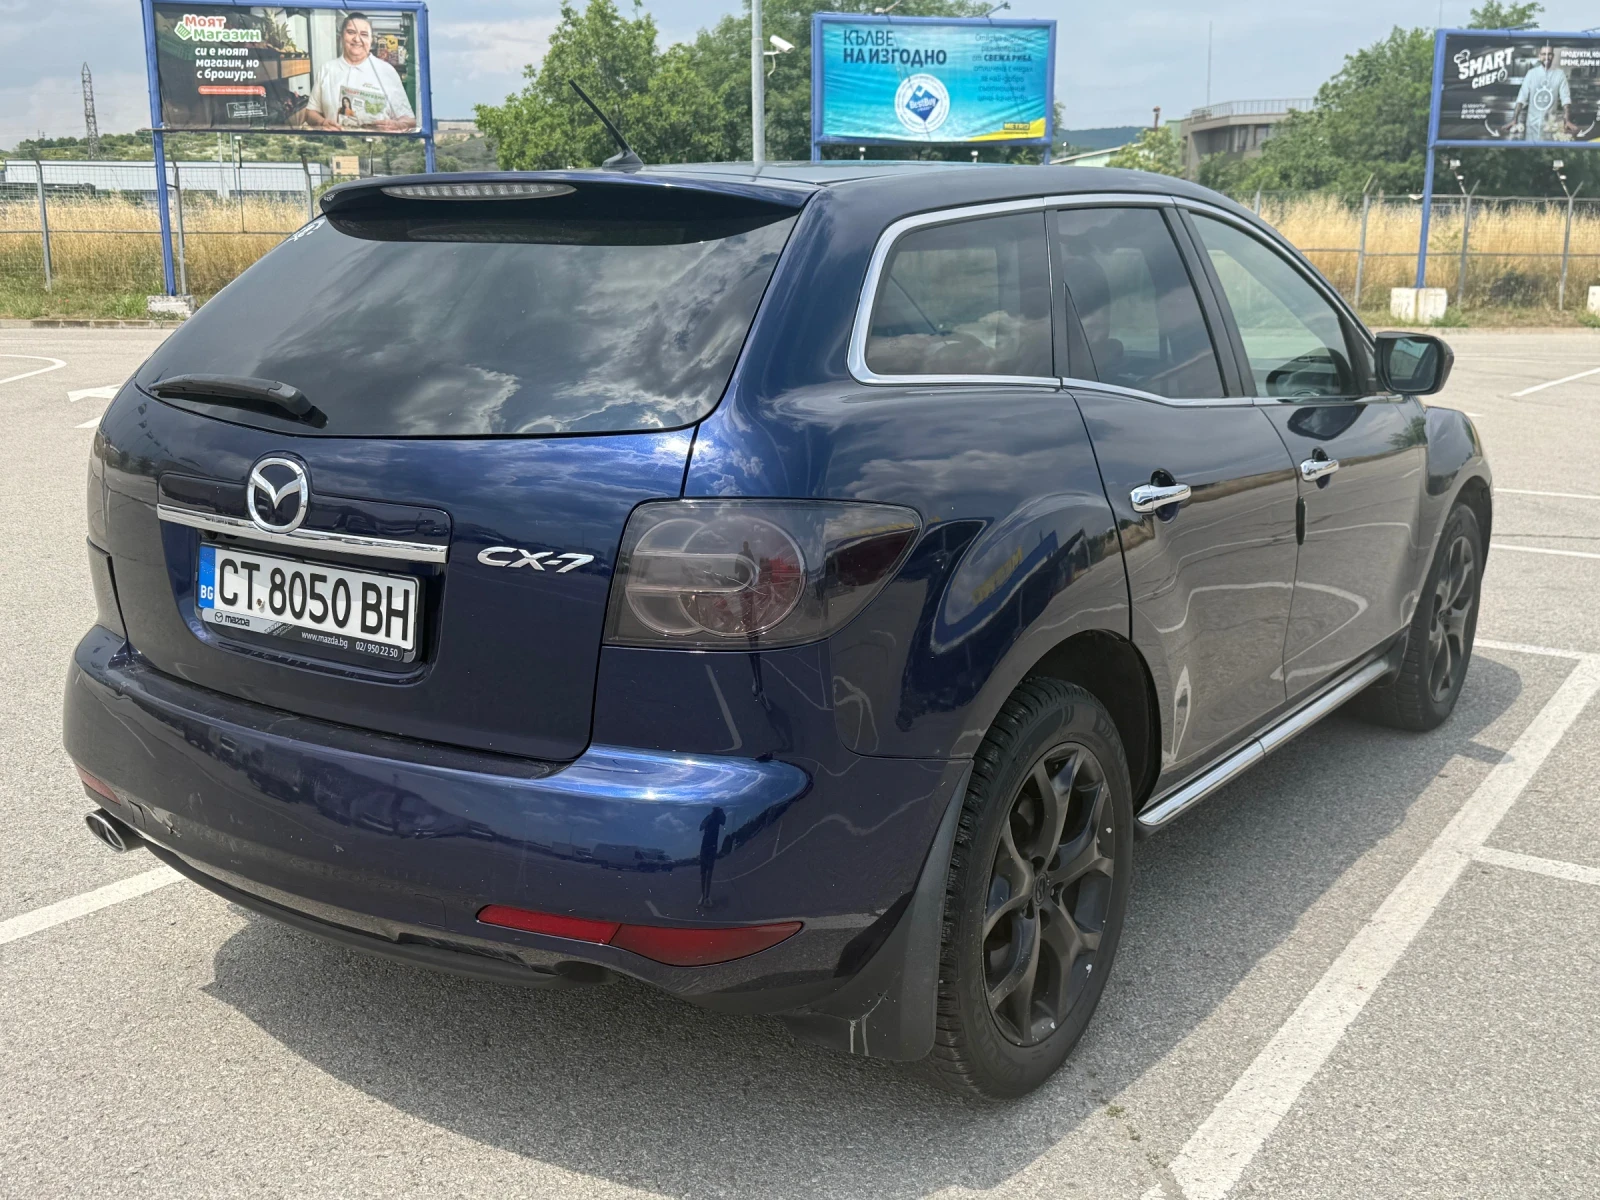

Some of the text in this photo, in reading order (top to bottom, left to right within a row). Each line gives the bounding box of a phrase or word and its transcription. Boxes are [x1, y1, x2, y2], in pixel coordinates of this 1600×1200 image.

[185, 16, 225, 27] Моят
[193, 29, 261, 41] Магазин
[844, 30, 894, 46] КЪЛВЕ
[195, 48, 207, 56] си
[218, 48, 248, 56] моят
[844, 48, 947, 68] НА ИЗГОДНО
[196, 59, 244, 69] магазин,
[1458, 47, 1515, 79] SMART
[197, 68, 257, 81] с брошура.
[1472, 71, 1498, 89] CHEF
[477, 546, 595, 573] CX-7
[200, 585, 214, 601] BG
[219, 558, 410, 642] CT 8050 BH
[225, 616, 251, 628] mazda
[301, 632, 348, 649] www.mazda.bg
[355, 641, 398, 657] 02/ 950 22 50
